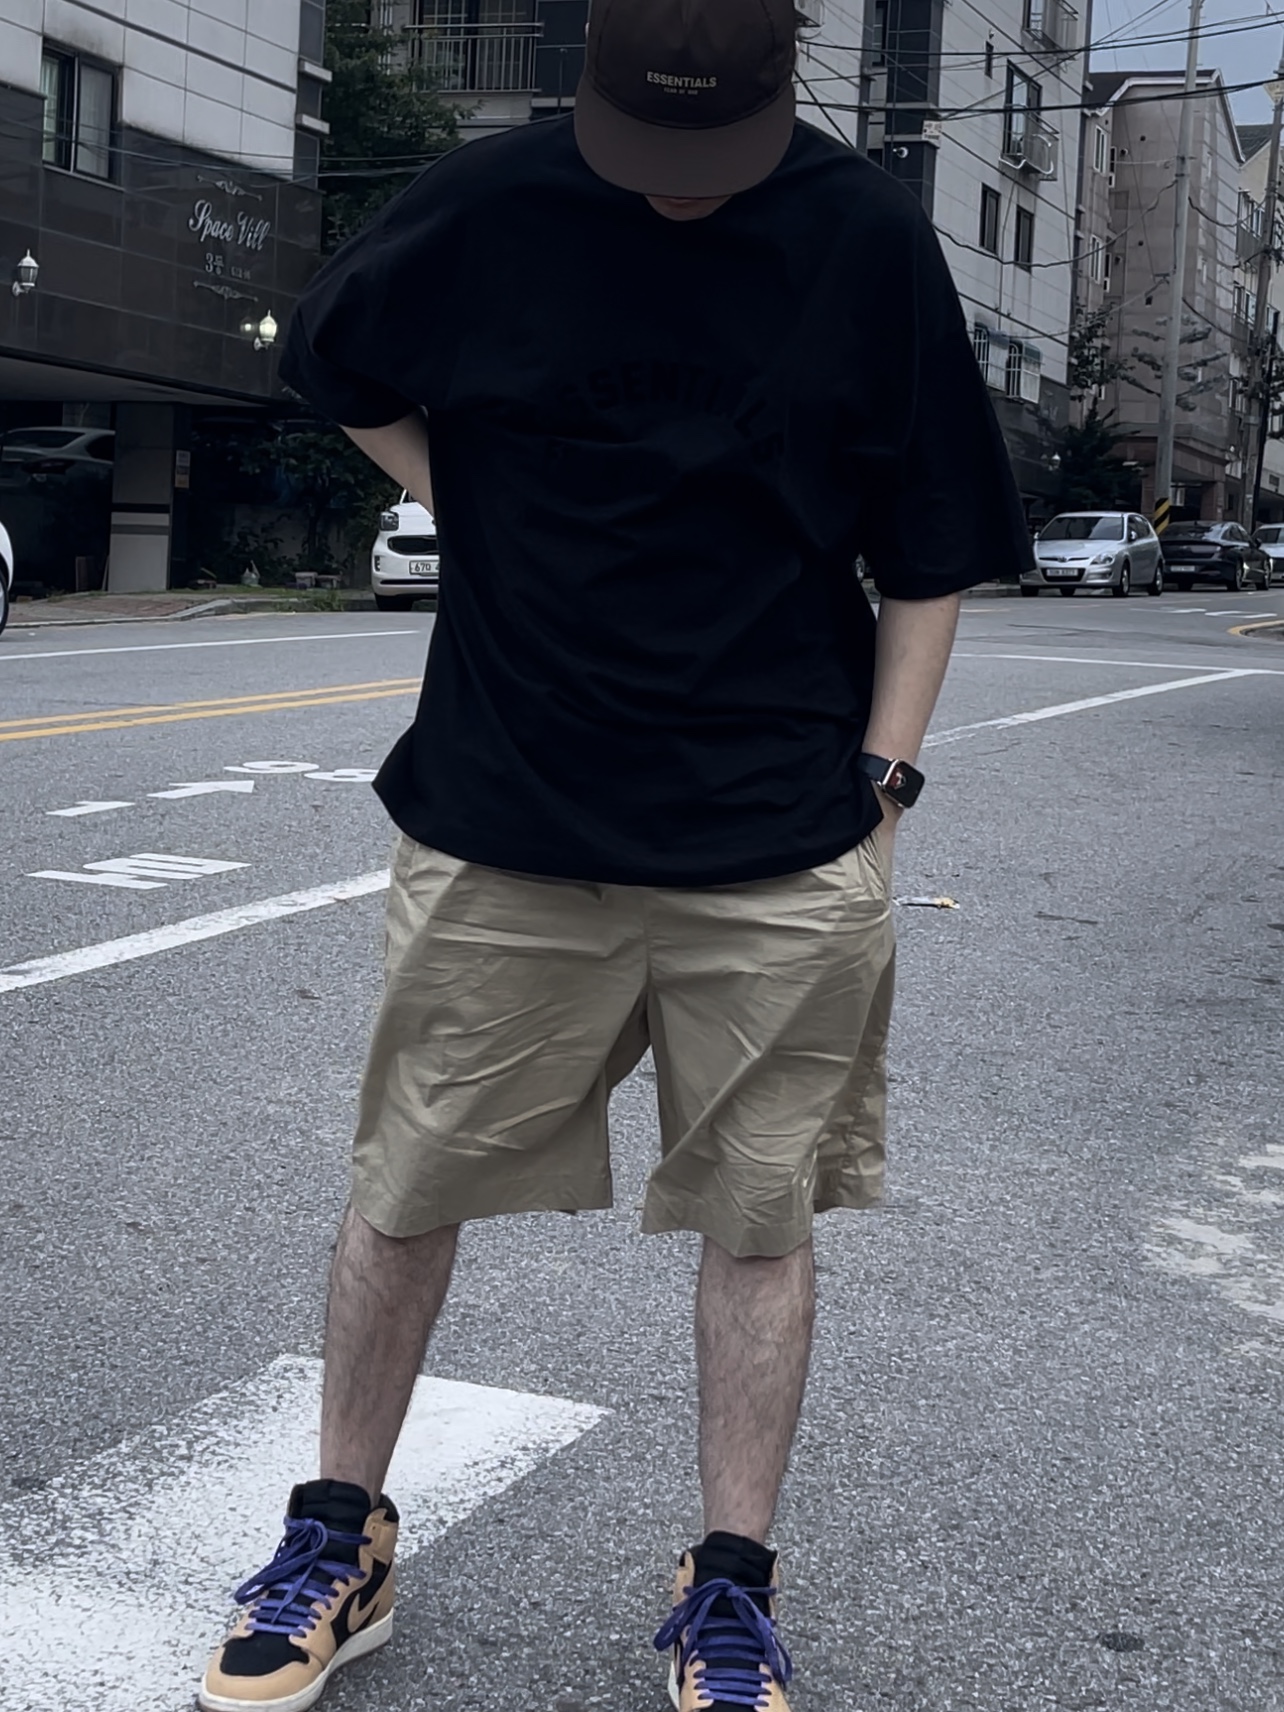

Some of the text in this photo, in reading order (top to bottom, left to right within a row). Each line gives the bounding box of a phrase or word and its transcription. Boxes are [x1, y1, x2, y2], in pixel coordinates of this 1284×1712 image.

[646, 71, 717, 88] ESSENTIALS
[189, 199, 271, 251] Space Vill
